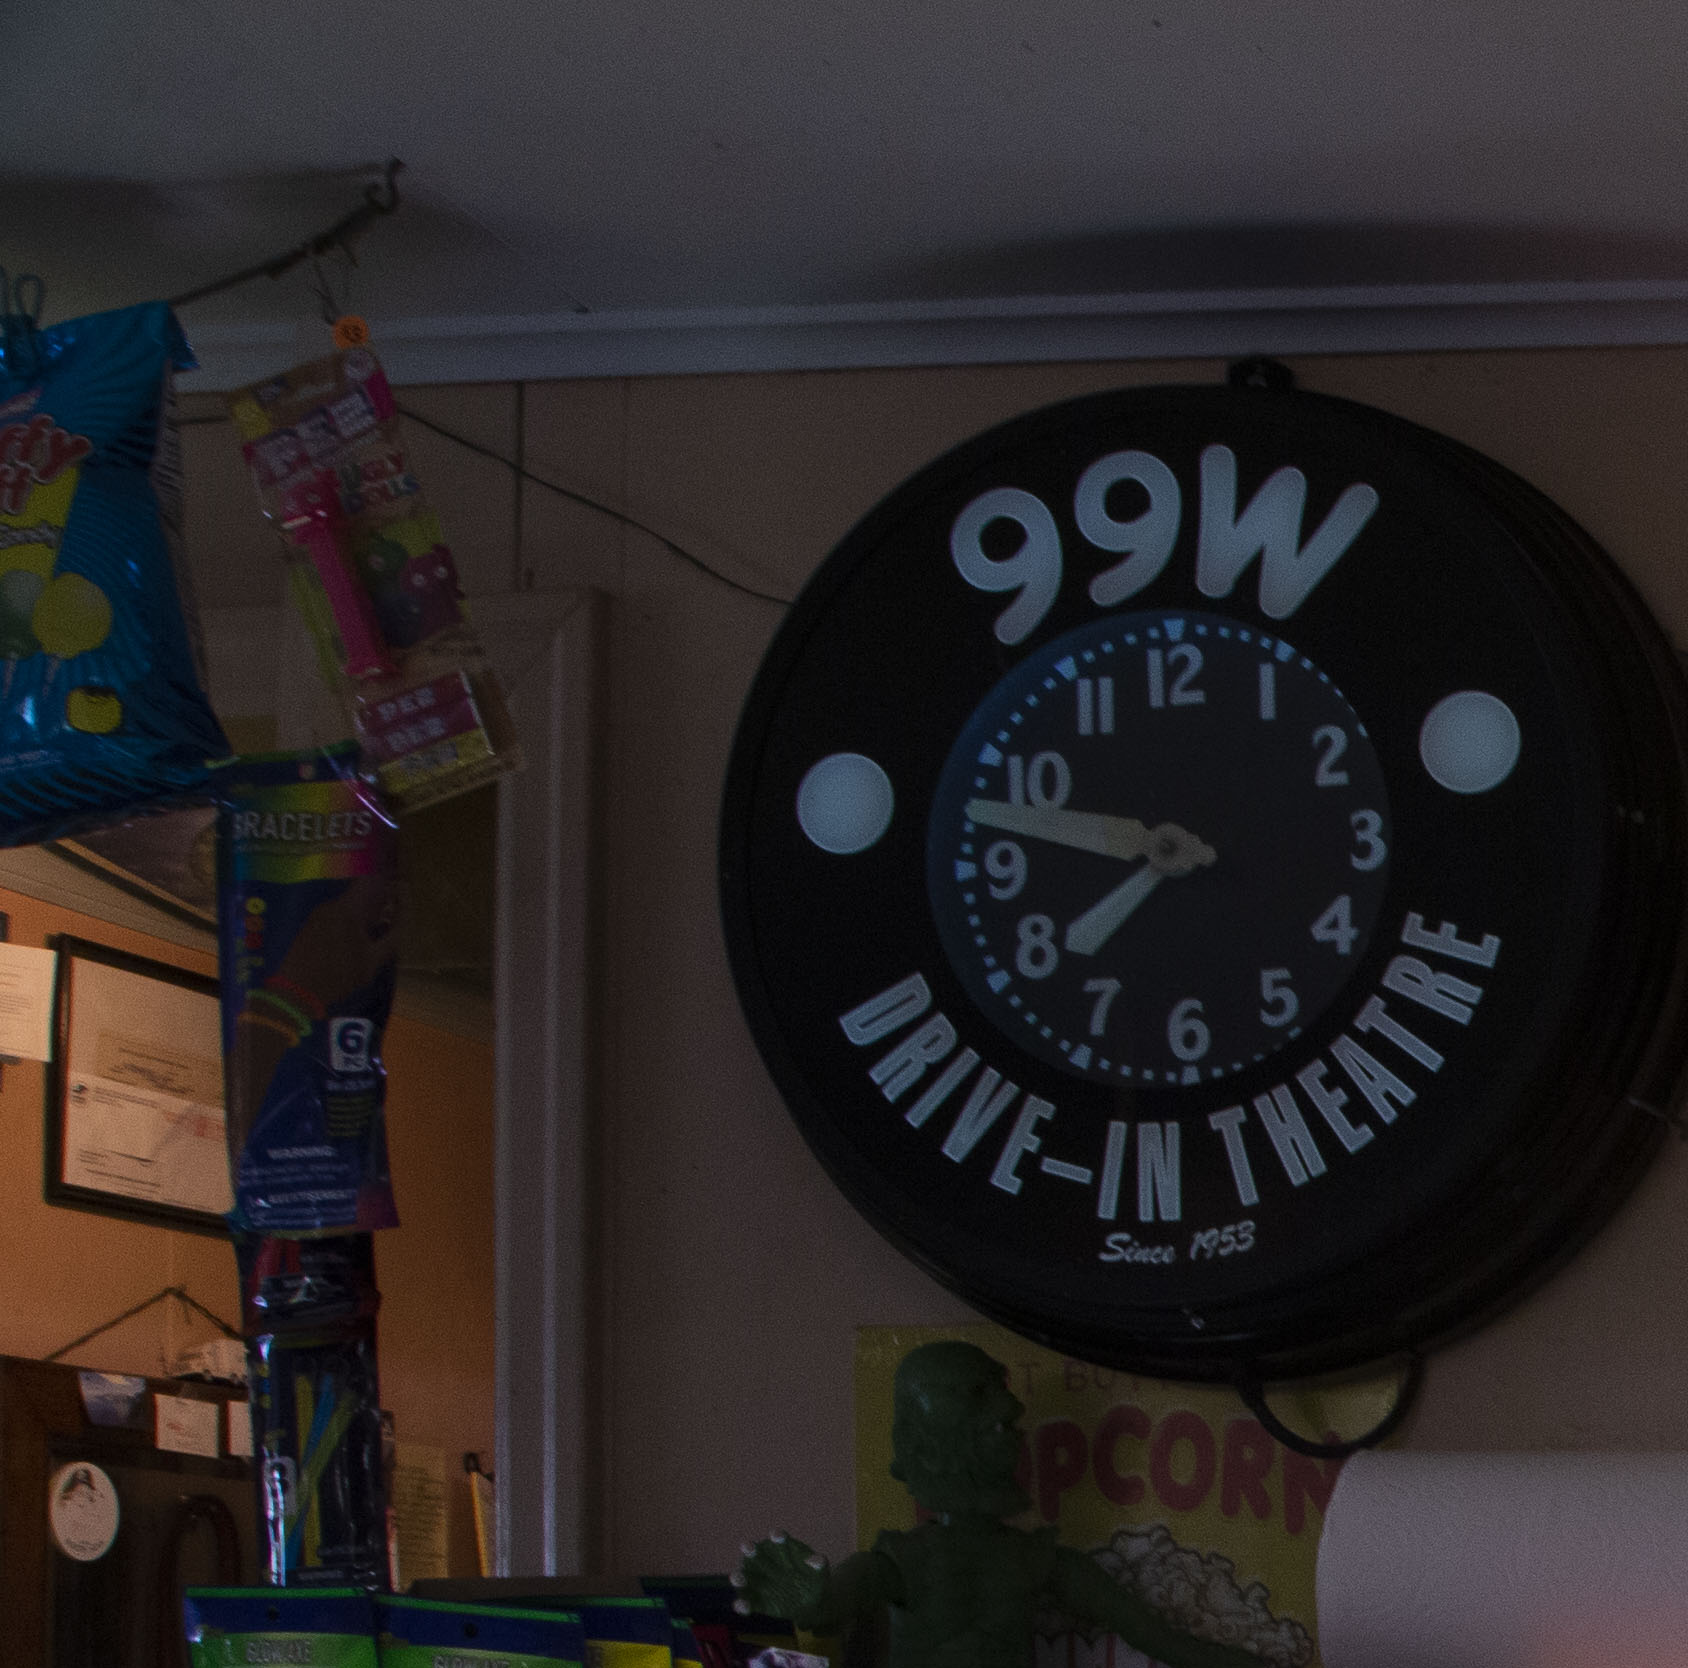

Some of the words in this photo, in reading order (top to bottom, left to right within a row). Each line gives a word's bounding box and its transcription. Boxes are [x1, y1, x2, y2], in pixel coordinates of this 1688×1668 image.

[950, 443, 1380, 645] 99W
[1075, 676, 1114, 735] 11
[1146, 645, 1205, 709] 12
[1257, 662, 1277, 720] 1
[1005, 750, 1072, 808] 10
[1312, 724, 1350, 786] 2
[232, 811, 373, 842] BRACELETS
[1349, 810, 1386, 872] 3
[984, 840, 1028, 900] 9
[1016, 914, 1059, 980] 8
[1312, 894, 1359, 955] 4
[1083, 978, 1123, 1036] 7
[1259, 967, 1299, 1027] 5
[339, 1022, 365, 1054] 6
[1167, 1000, 1211, 1063] 6
[837, 971, 1182, 1222] DRIVE-IN
[1208, 911, 1502, 1206] THEATRE
[1098, 1232, 1176, 1265] Since
[1189, 1220, 1257, 1262] 1953
[246, 1641, 286, 1664] GLOW
[288, 1640, 313, 1663] AXE
